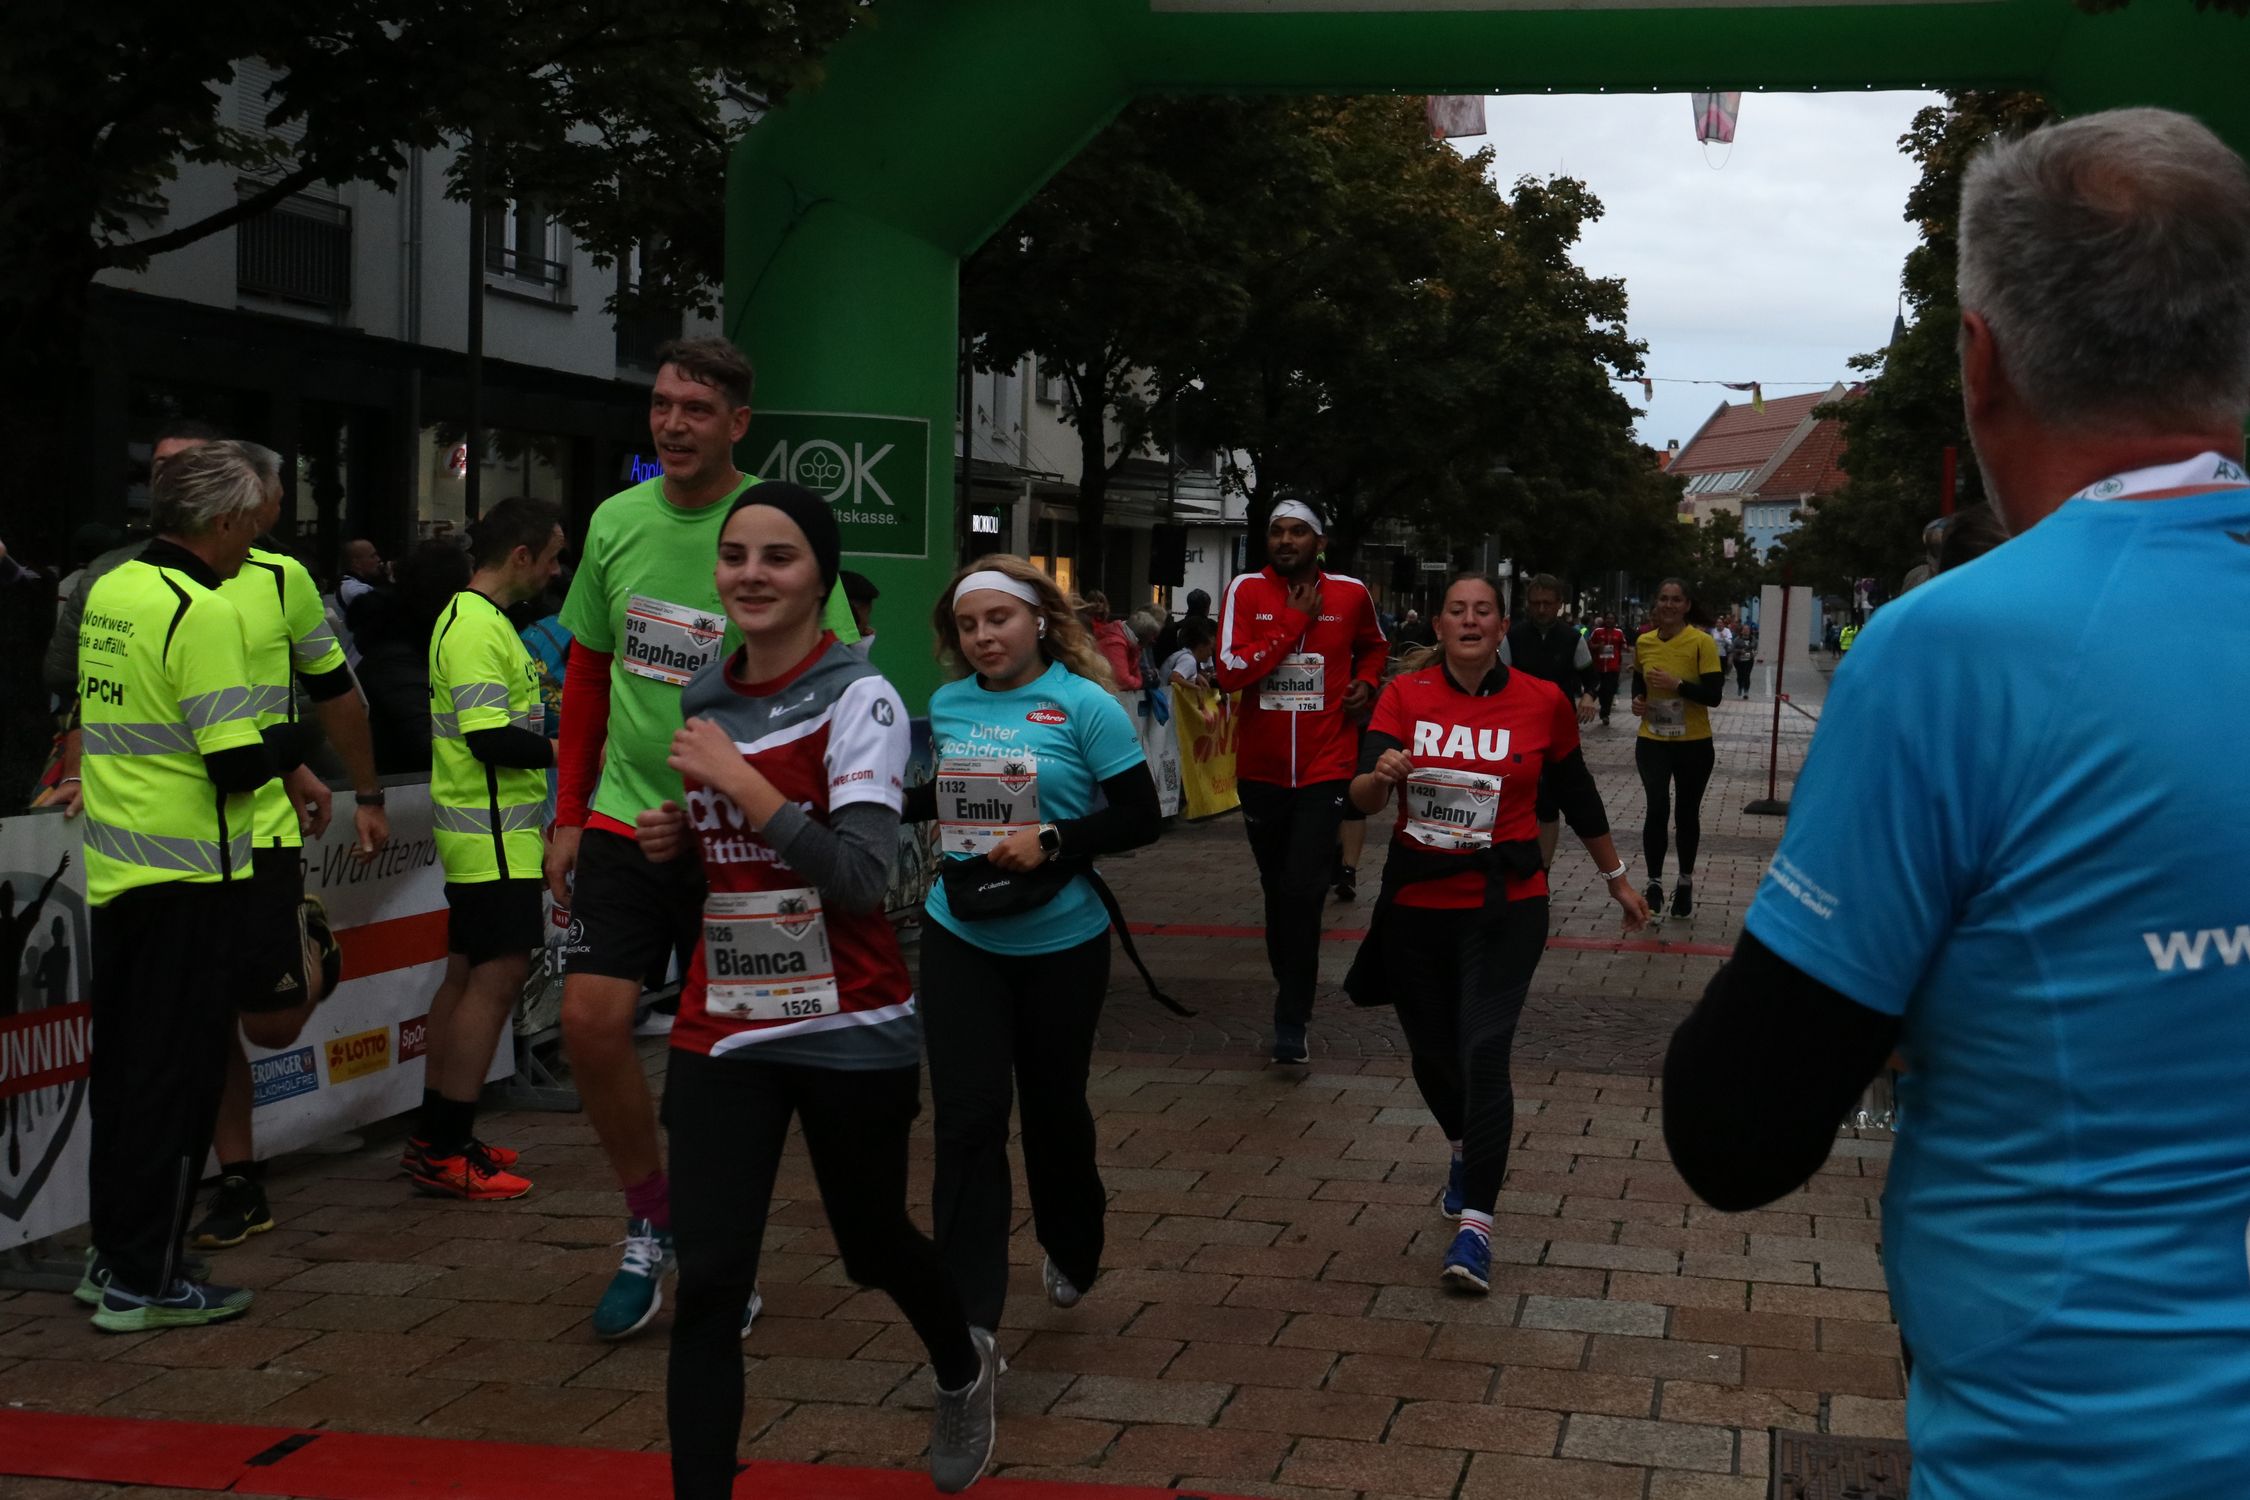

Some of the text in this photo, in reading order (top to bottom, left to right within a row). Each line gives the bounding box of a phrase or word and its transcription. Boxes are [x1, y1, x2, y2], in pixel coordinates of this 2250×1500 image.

[757, 439, 895, 505] AOK
[626, 619, 647, 634] 918
[627, 635, 708, 672] Raphael
[86, 677, 123, 706] PCH
[1266, 678, 1314, 692] Arshad
[970, 724, 1020, 740] Unter
[1413, 720, 1510, 761] RAU
[938, 780, 966, 793] 1132
[1410, 785, 1436, 797] 1420
[955, 798, 1012, 824] Emily
[1421, 801, 1477, 828] Jenny
[715, 948, 807, 976] Bianca
[782, 998, 822, 1016] 1526
[345, 1034, 386, 1062] LOTTO
[251, 1054, 304, 1084] ERDINGER
[253, 1074, 318, 1099] ALKOHOLFREI
